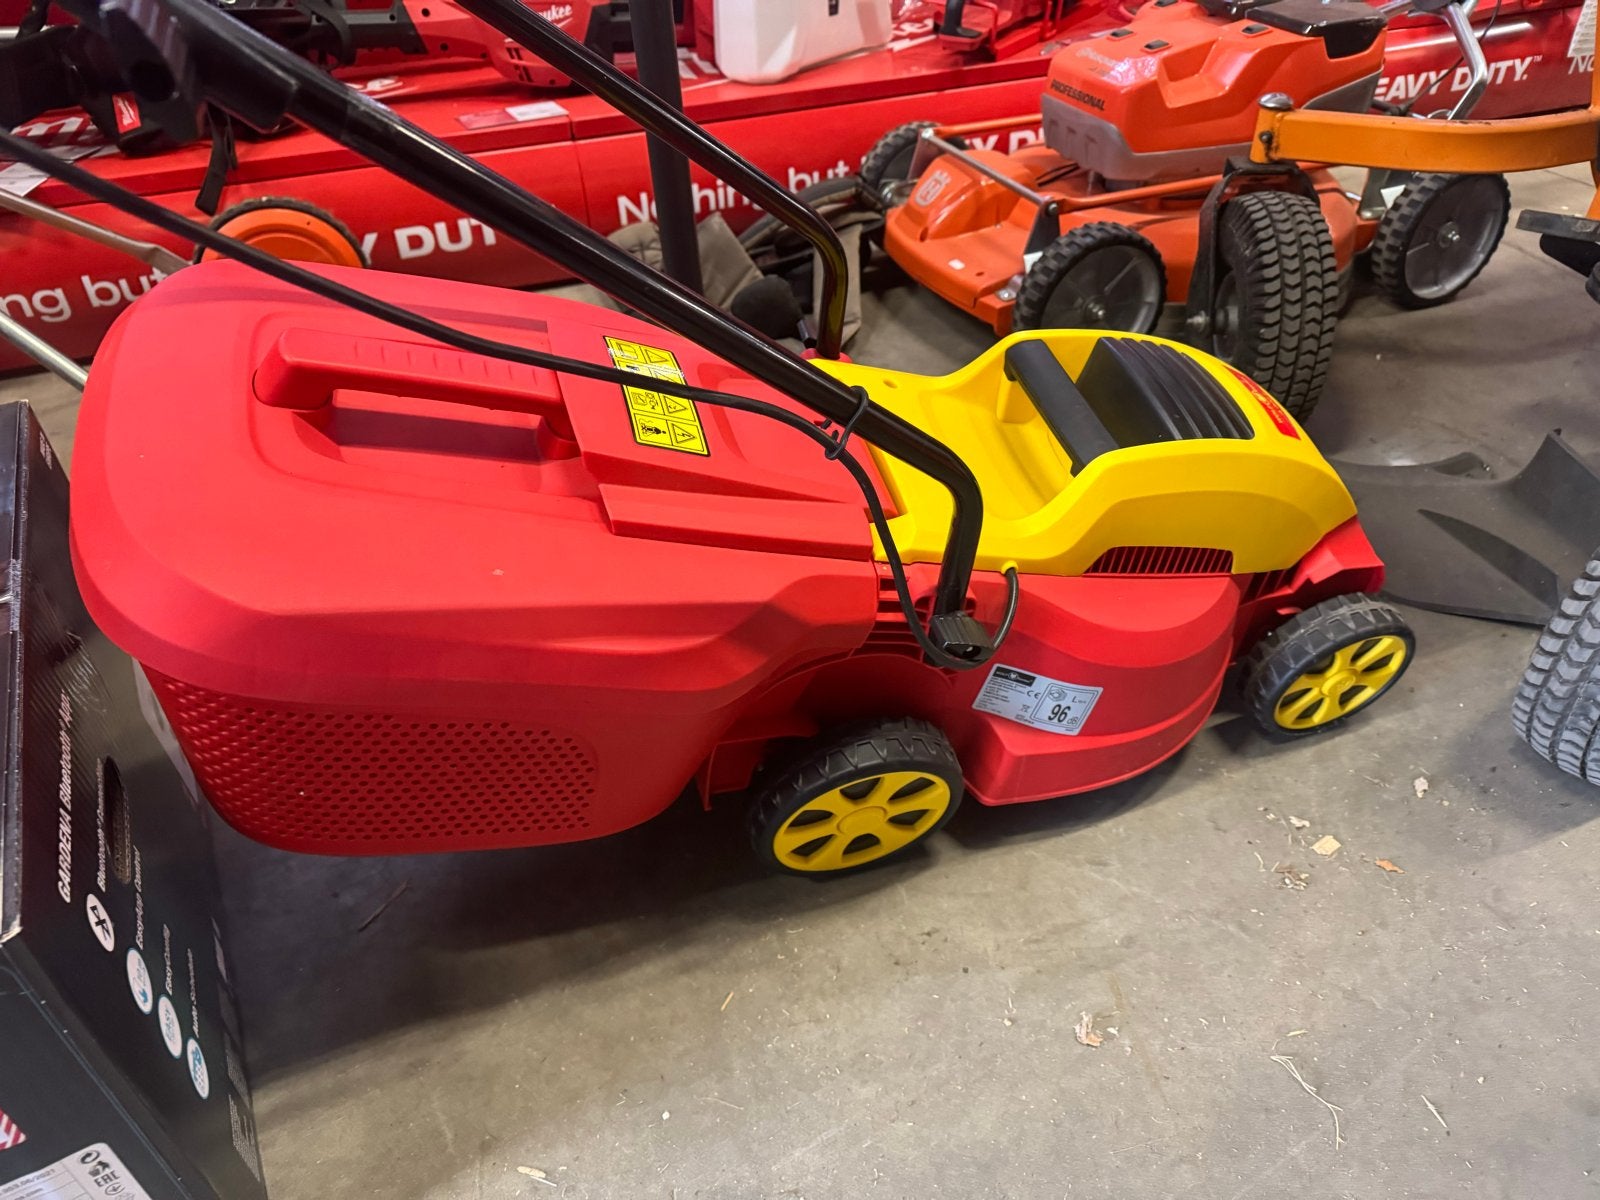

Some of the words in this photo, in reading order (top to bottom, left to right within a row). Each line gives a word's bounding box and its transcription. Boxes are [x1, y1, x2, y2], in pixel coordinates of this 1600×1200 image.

[1050, 79, 1105, 111] PROFESSIONAL
[1374, 68, 1448, 102] EAVY
[394, 217, 497, 260] DUT
[1048, 704, 1071, 723] 96
[58, 808, 72, 903] GARDENA
